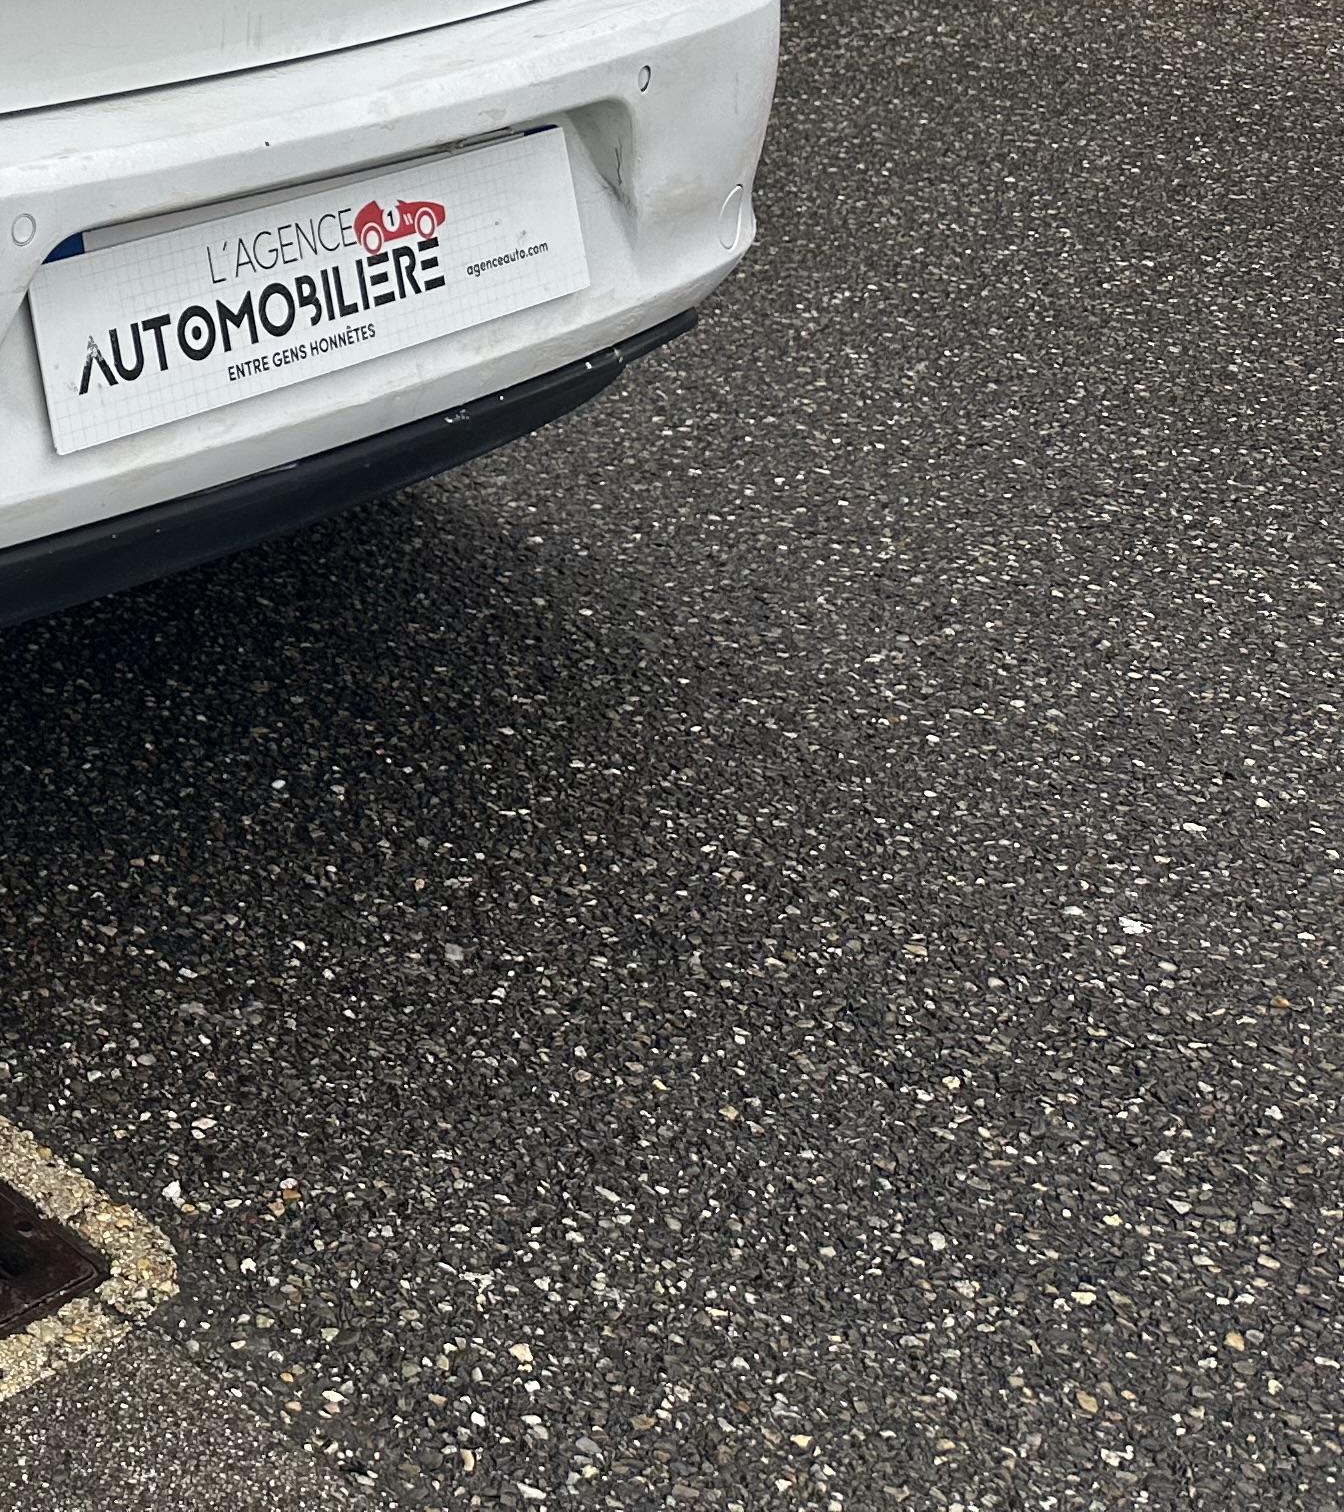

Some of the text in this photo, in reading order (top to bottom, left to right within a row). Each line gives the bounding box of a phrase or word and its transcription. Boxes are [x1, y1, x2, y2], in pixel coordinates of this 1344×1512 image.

[206, 207, 358, 284] L'AGENCE
[466, 241, 549, 278] agenceauto.com
[78, 236, 446, 396] AUTOMOBILIERE
[227, 323, 376, 382] ENTRE GENS HONNÊTES
